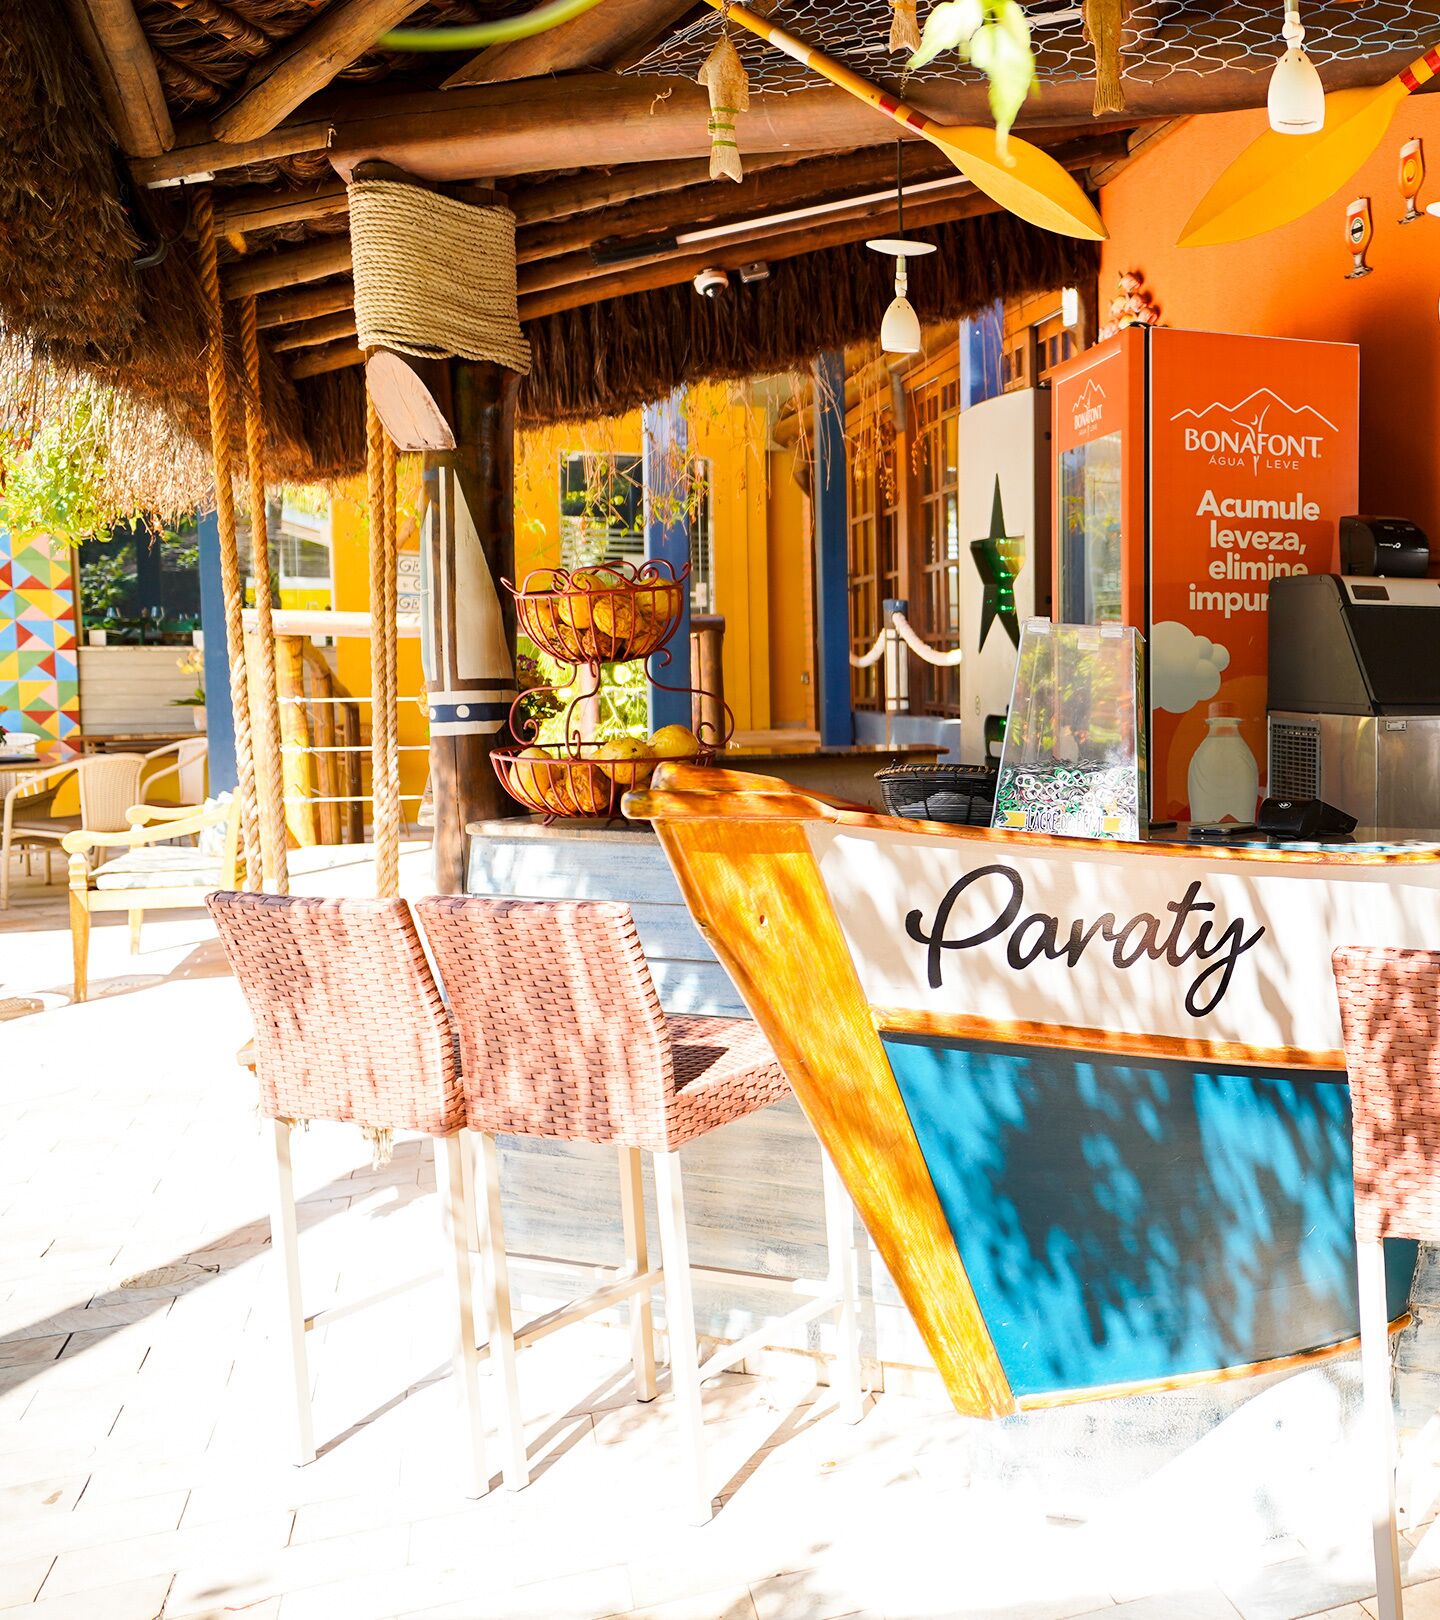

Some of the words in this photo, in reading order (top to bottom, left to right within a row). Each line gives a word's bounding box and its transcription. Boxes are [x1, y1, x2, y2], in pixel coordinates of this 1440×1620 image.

[1184, 427, 1325, 459] BONAFONT
[1208, 455, 1245, 467] ÁGUA
[1266, 459, 1300, 470] LEVE
[1196, 489, 1321, 521] Acumule
[1210, 520, 1307, 555] leveza,
[1208, 552, 1309, 581] elimine
[905, 863, 1266, 1018] Paraty
